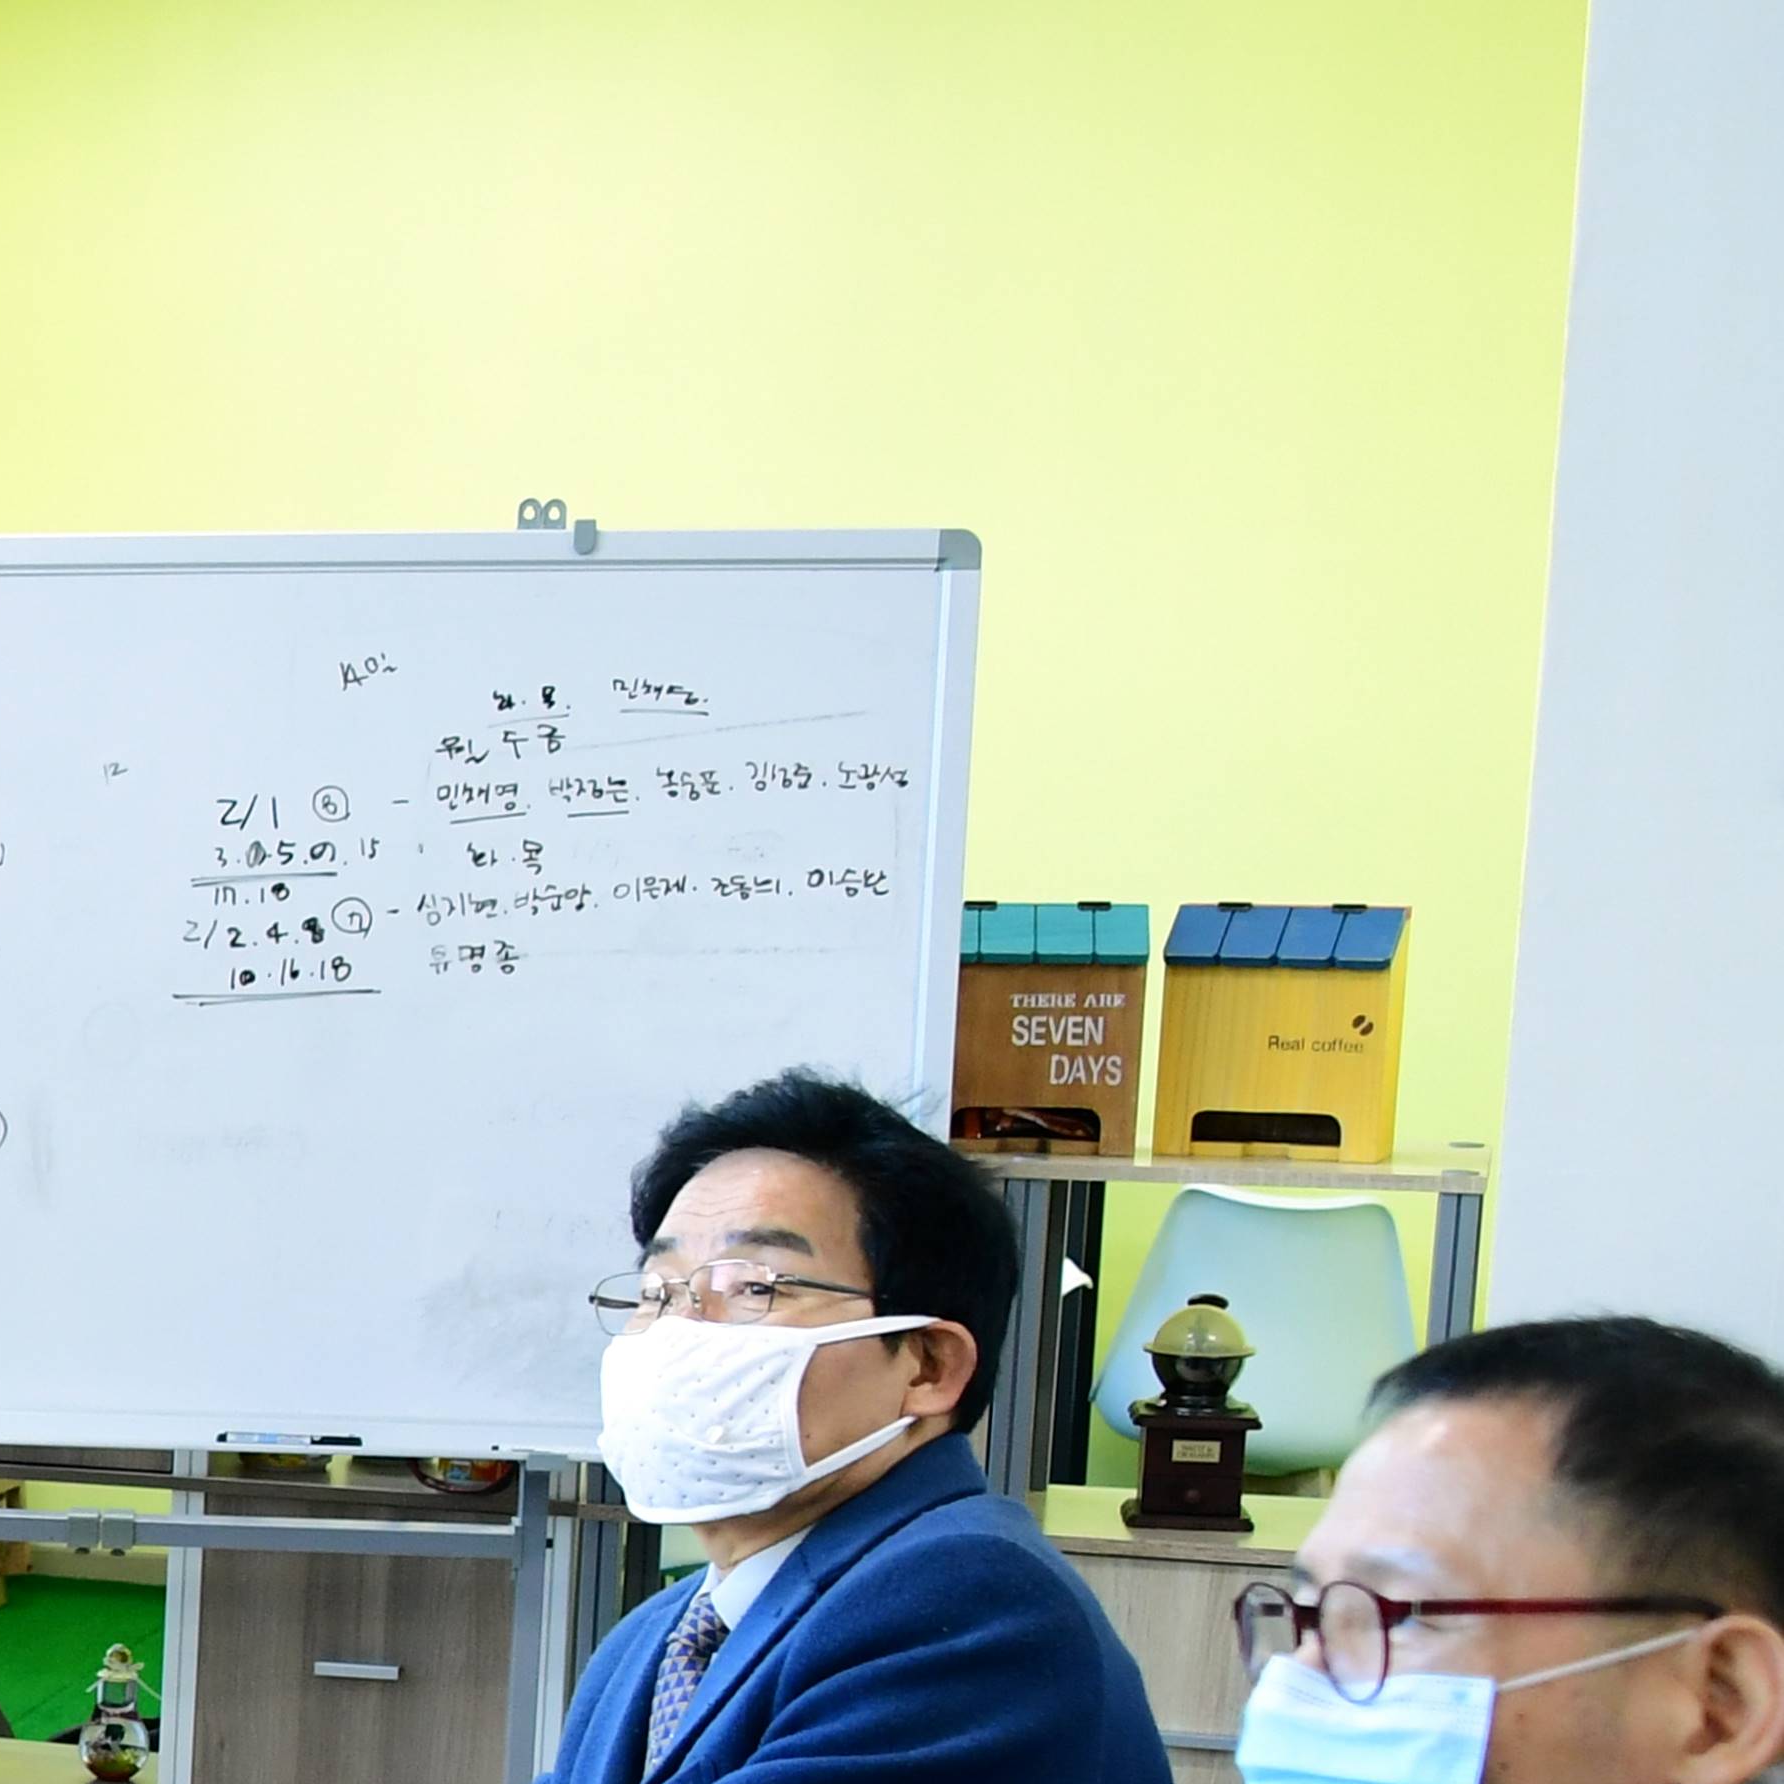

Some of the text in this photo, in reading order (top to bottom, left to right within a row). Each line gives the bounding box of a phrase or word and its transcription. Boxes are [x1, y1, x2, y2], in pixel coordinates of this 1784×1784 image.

[1010, 993, 1126, 1008] THERE ARE
[1011, 1015, 1104, 1047] SEVEN
[1268, 1035, 1364, 1054] Real coffee
[1050, 1054, 1122, 1086] DAYS
